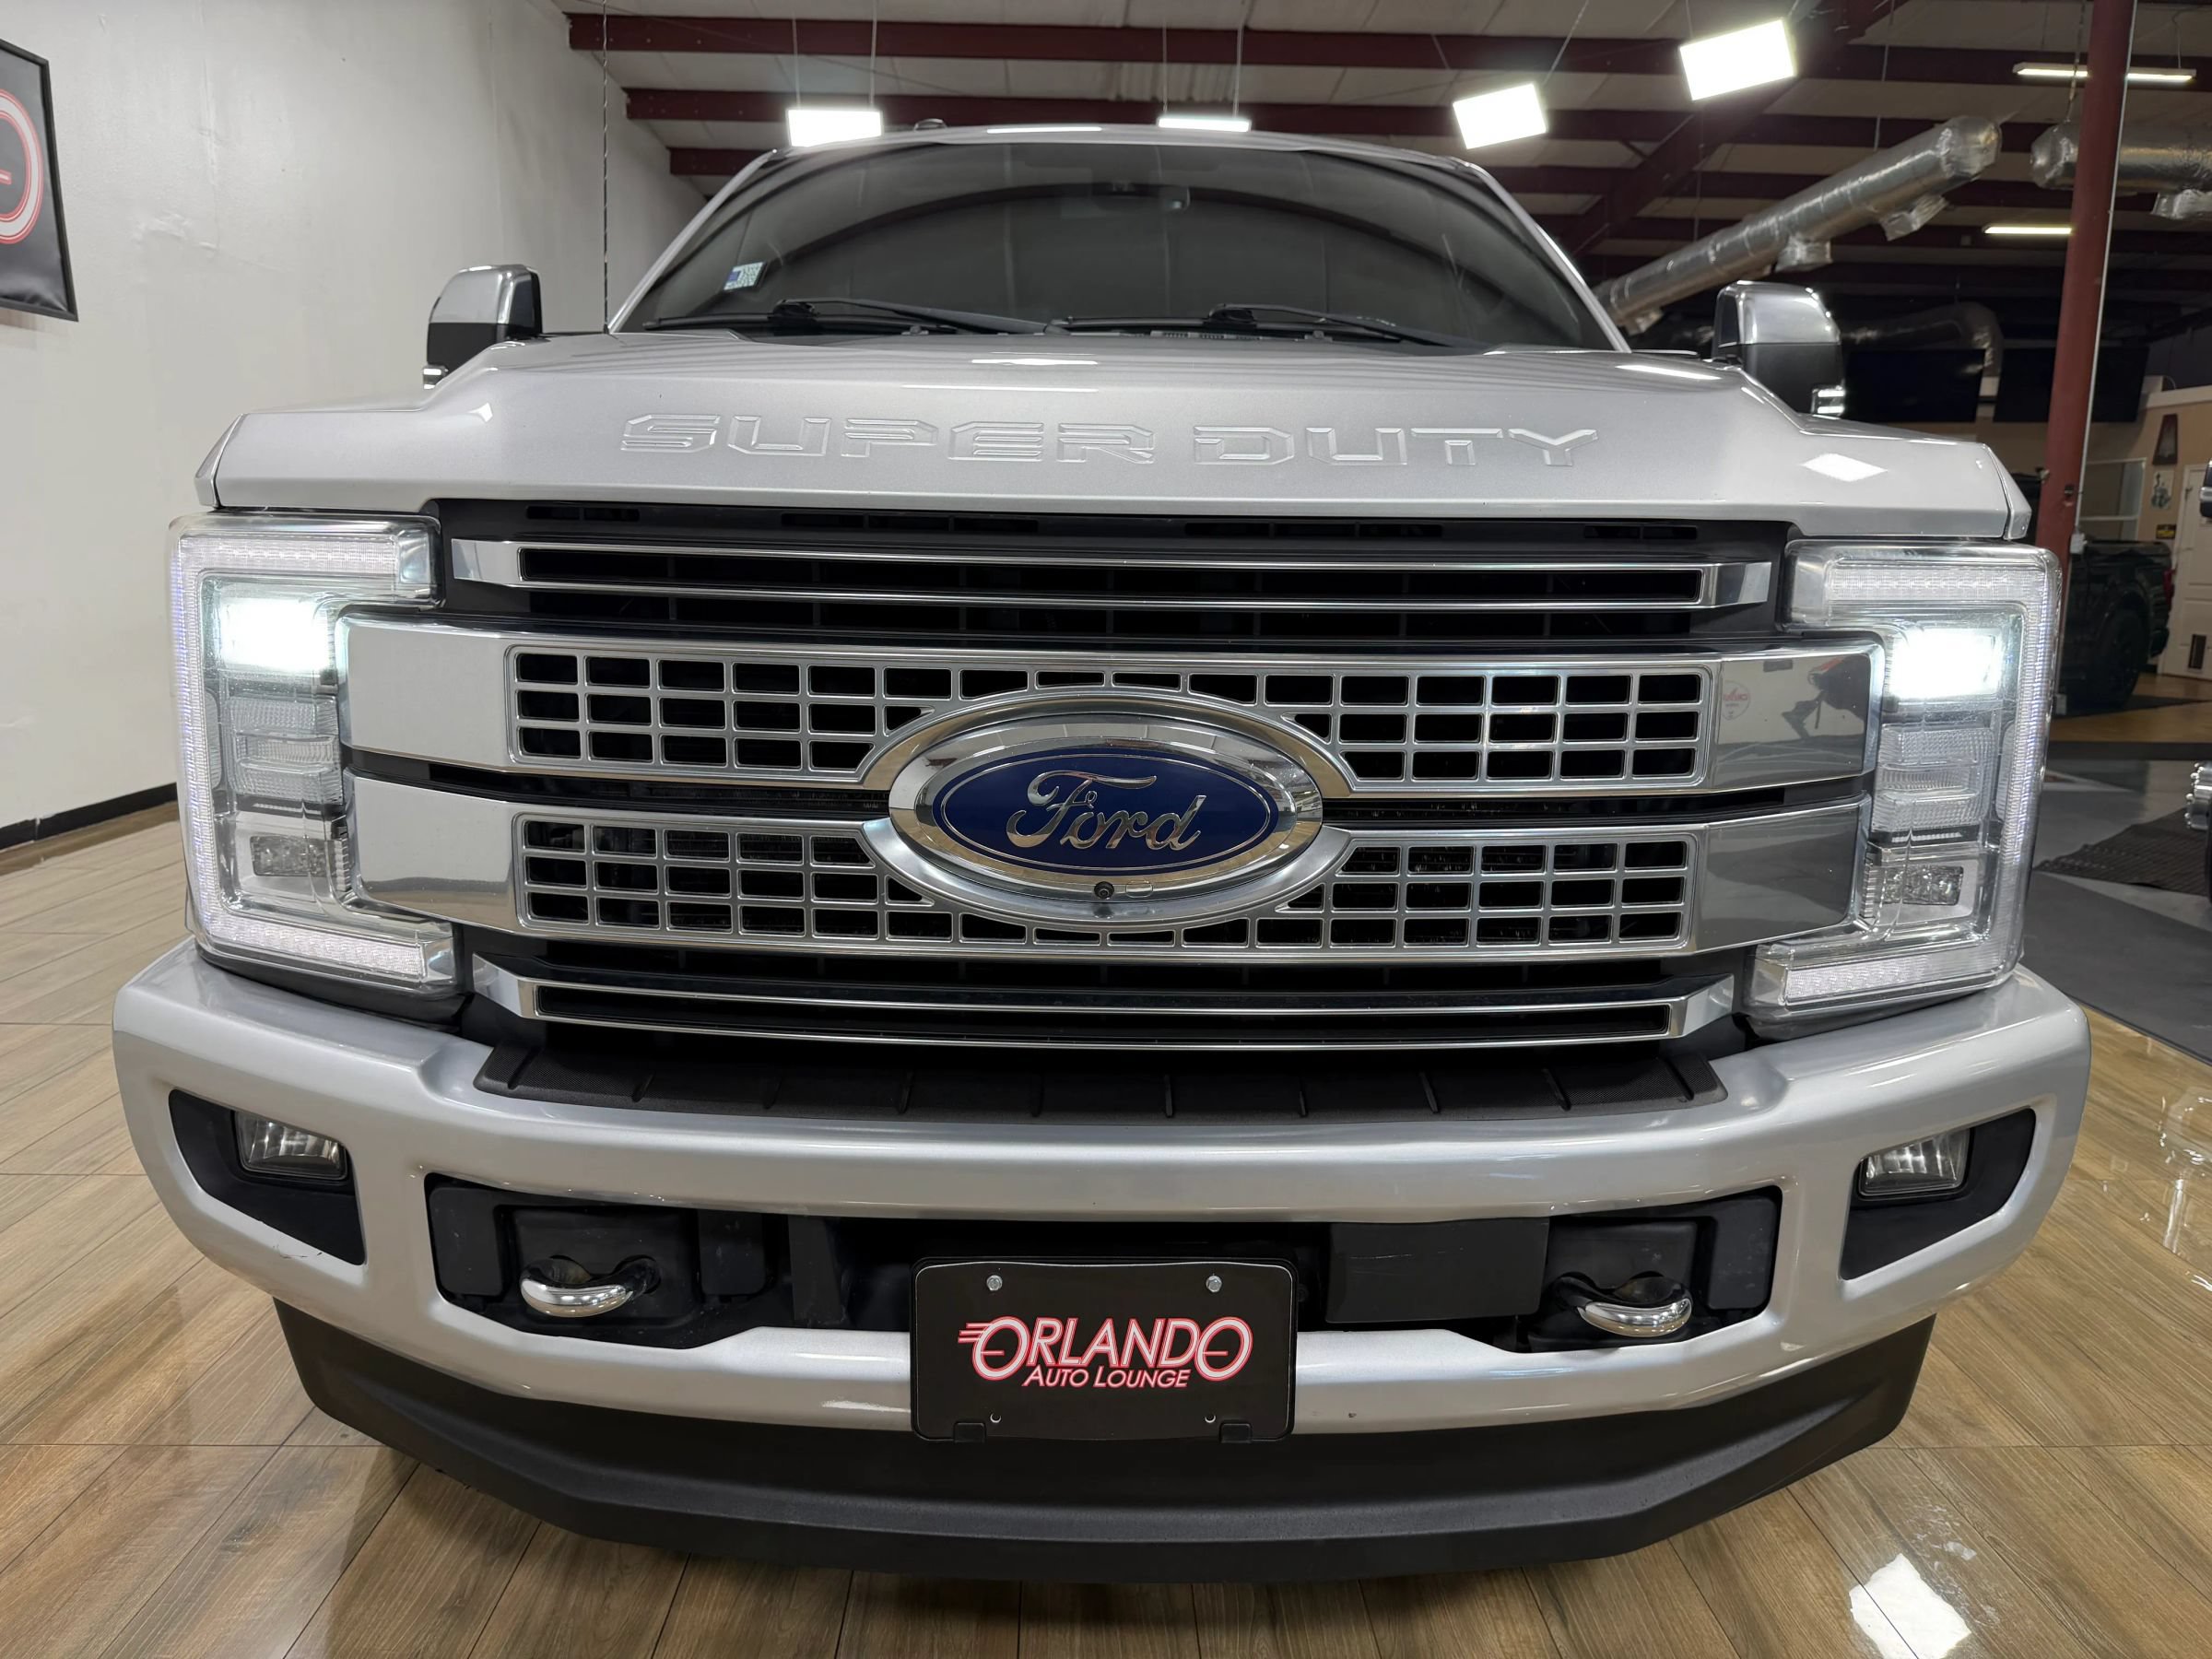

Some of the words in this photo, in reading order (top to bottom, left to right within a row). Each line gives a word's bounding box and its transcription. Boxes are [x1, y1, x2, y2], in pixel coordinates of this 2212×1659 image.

[620, 413, 1156, 465] SUPER
[1193, 423, 1599, 467] DUTY
[1005, 770, 1207, 851] Ford
[971, 1315, 1254, 1382] ORLANDO
[1021, 1366, 1089, 1387] AUTO
[1092, 1366, 1193, 1389] LOUNGE
